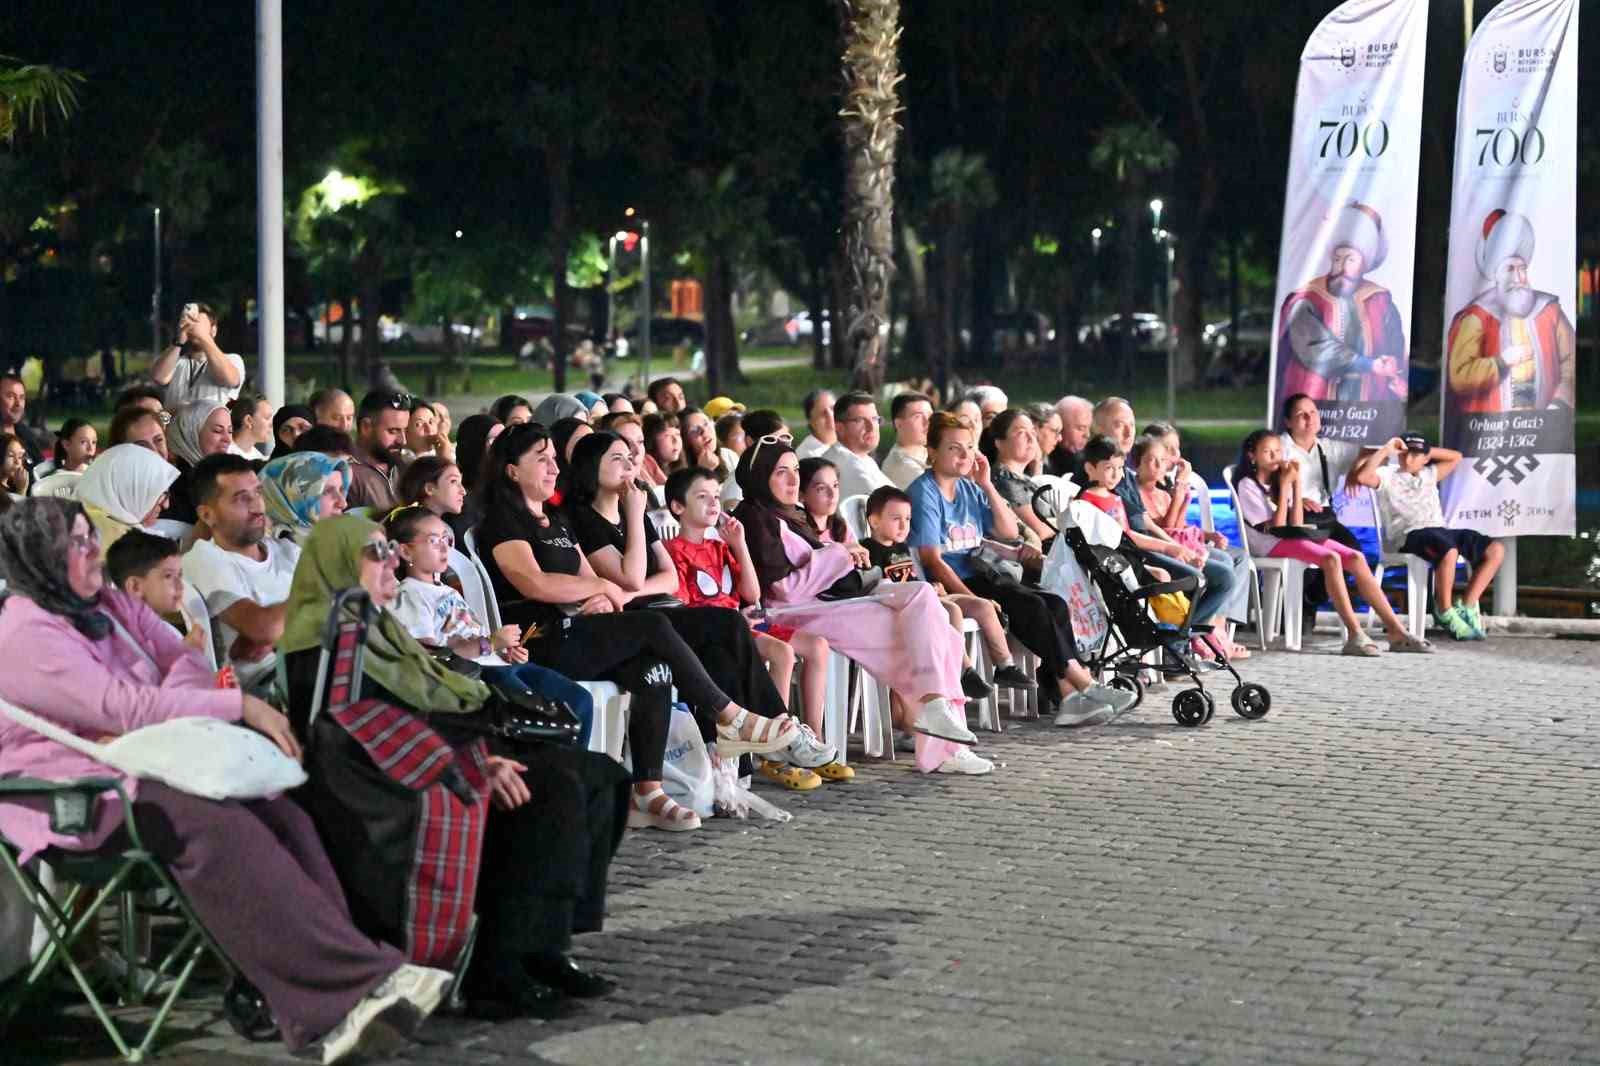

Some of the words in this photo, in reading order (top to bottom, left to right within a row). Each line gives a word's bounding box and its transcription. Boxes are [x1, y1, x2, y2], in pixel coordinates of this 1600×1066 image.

[1320, 120, 1389, 158] 700
[1476, 128, 1545, 167] 700
[1322, 424, 1368, 438] 99-1324
[1470, 417, 1509, 431] Orhan
[1512, 416, 1544, 429] Gazi
[1477, 434, 1537, 450] 1324-1362
